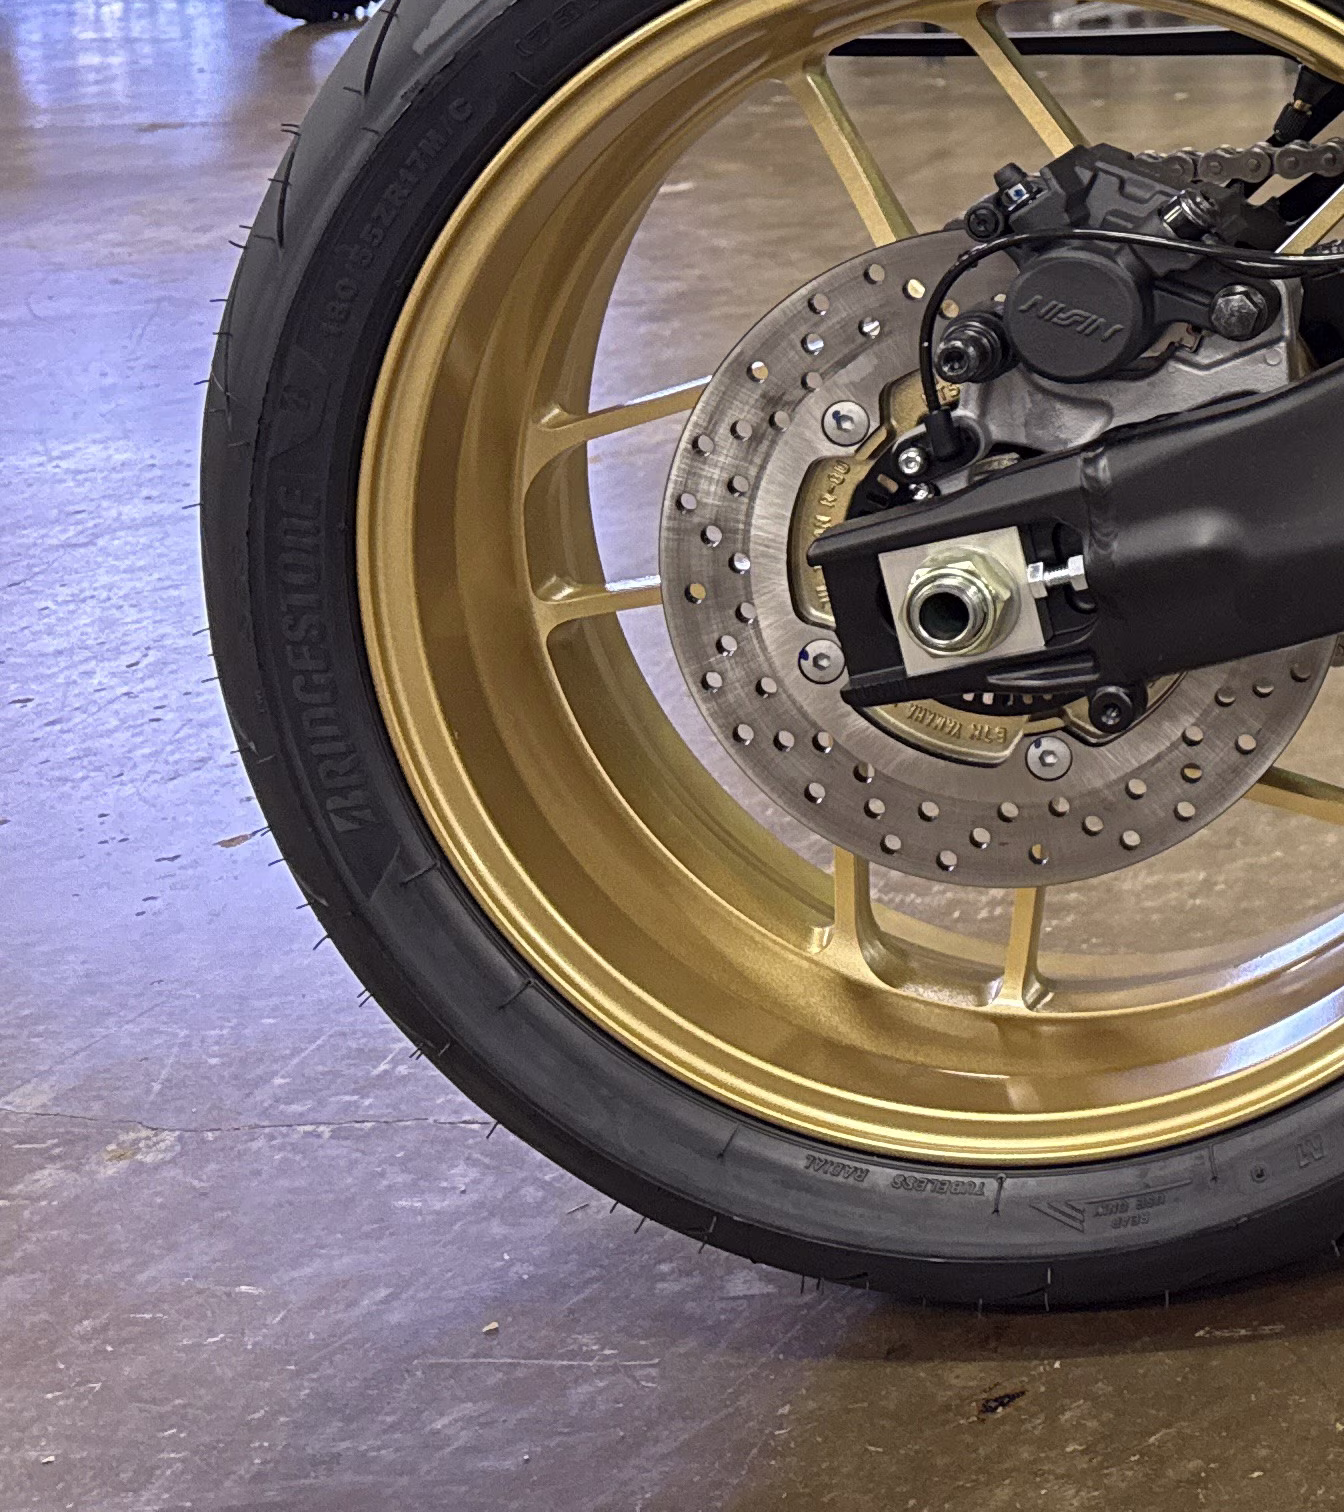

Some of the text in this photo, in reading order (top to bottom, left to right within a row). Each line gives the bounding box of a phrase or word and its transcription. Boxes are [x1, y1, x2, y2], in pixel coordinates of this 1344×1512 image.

[273, 483, 378, 839] BRIDGESTONE
[800, 1150, 870, 1184] RADIAL
[888, 1170, 986, 1197] TUBELESS
